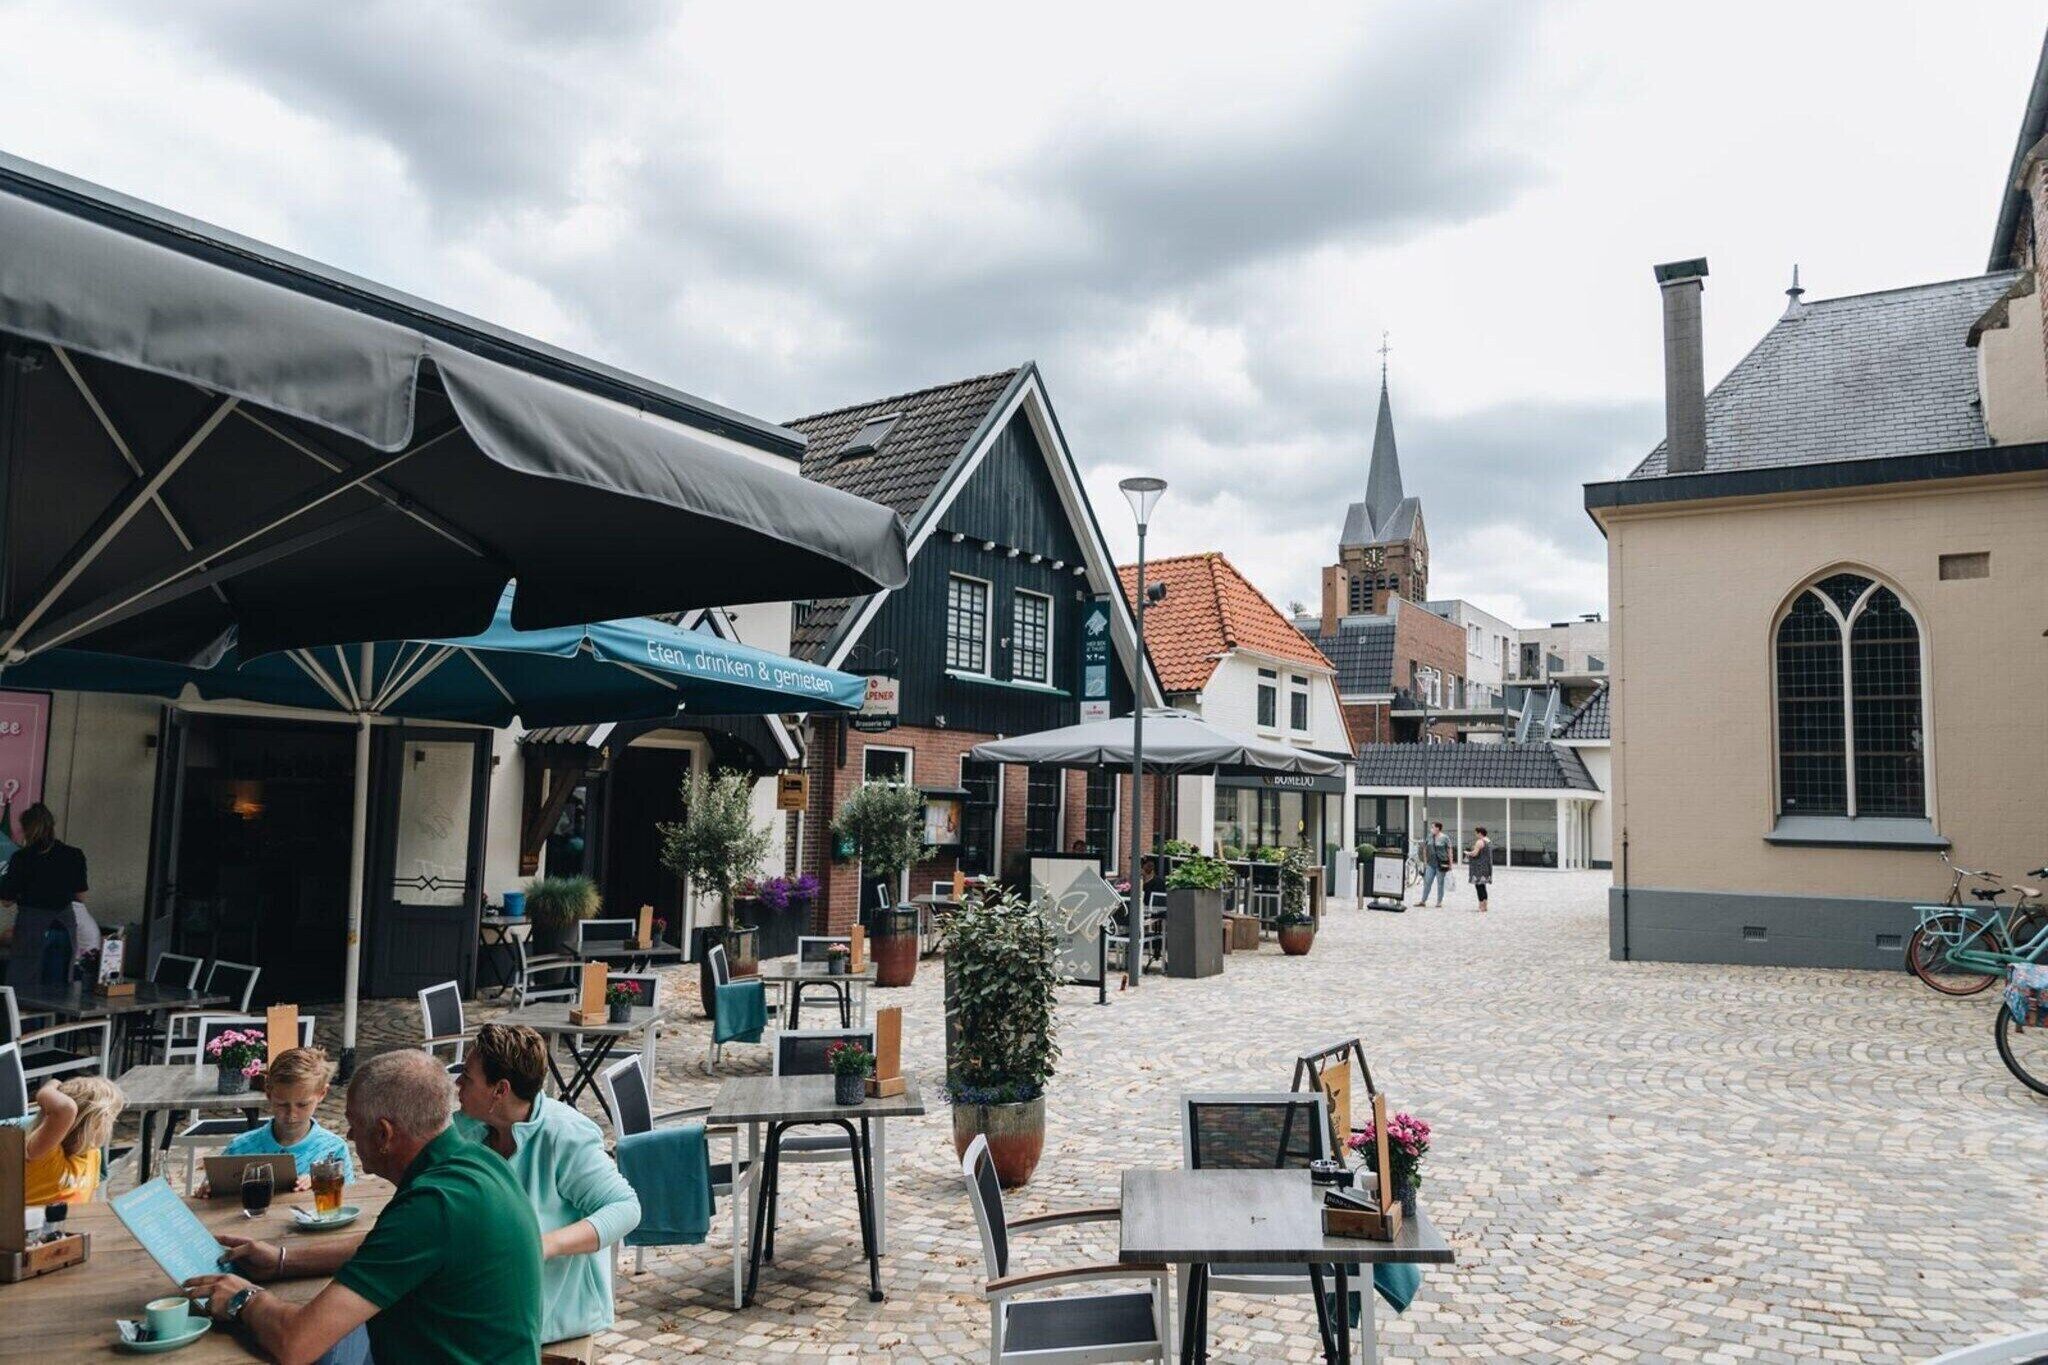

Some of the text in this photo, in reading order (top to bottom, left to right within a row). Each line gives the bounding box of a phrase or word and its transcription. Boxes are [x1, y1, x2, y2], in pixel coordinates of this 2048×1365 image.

[647, 640, 834, 694] Eten, drinken & genieten
